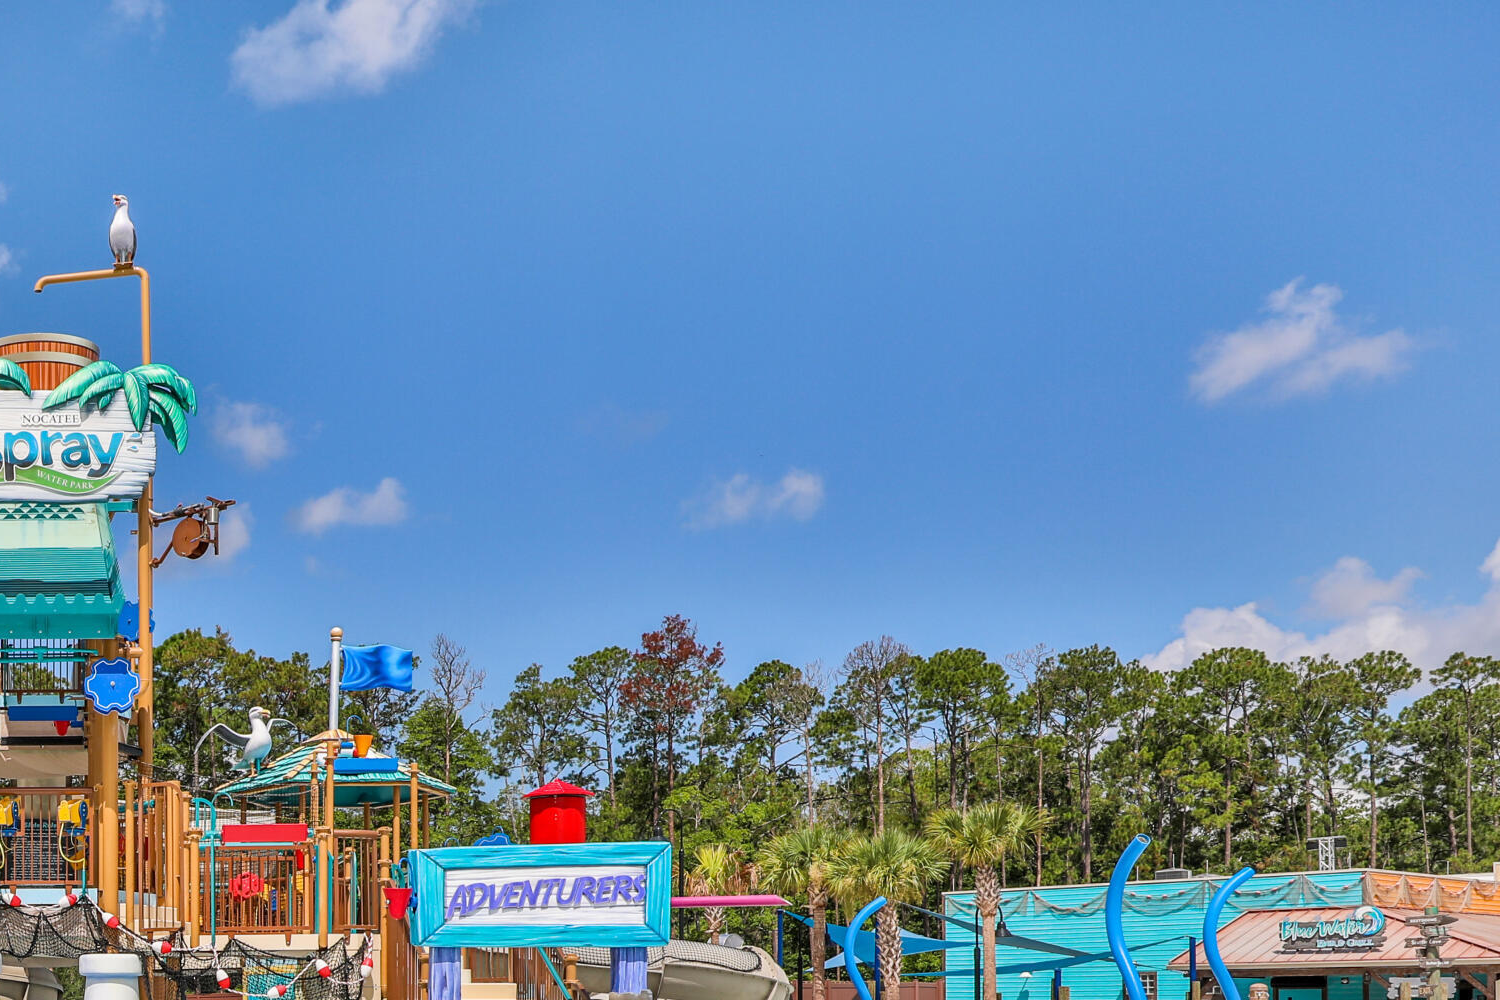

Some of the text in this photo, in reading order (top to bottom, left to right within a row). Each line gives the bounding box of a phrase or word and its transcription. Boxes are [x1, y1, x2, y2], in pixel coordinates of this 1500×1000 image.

[21, 414, 80, 424] NOCATEE
[37, 469, 95, 489] WATER PARK
[445, 874, 647, 921] ADVENTURERS
[1281, 917, 1371, 941] Blue Water
